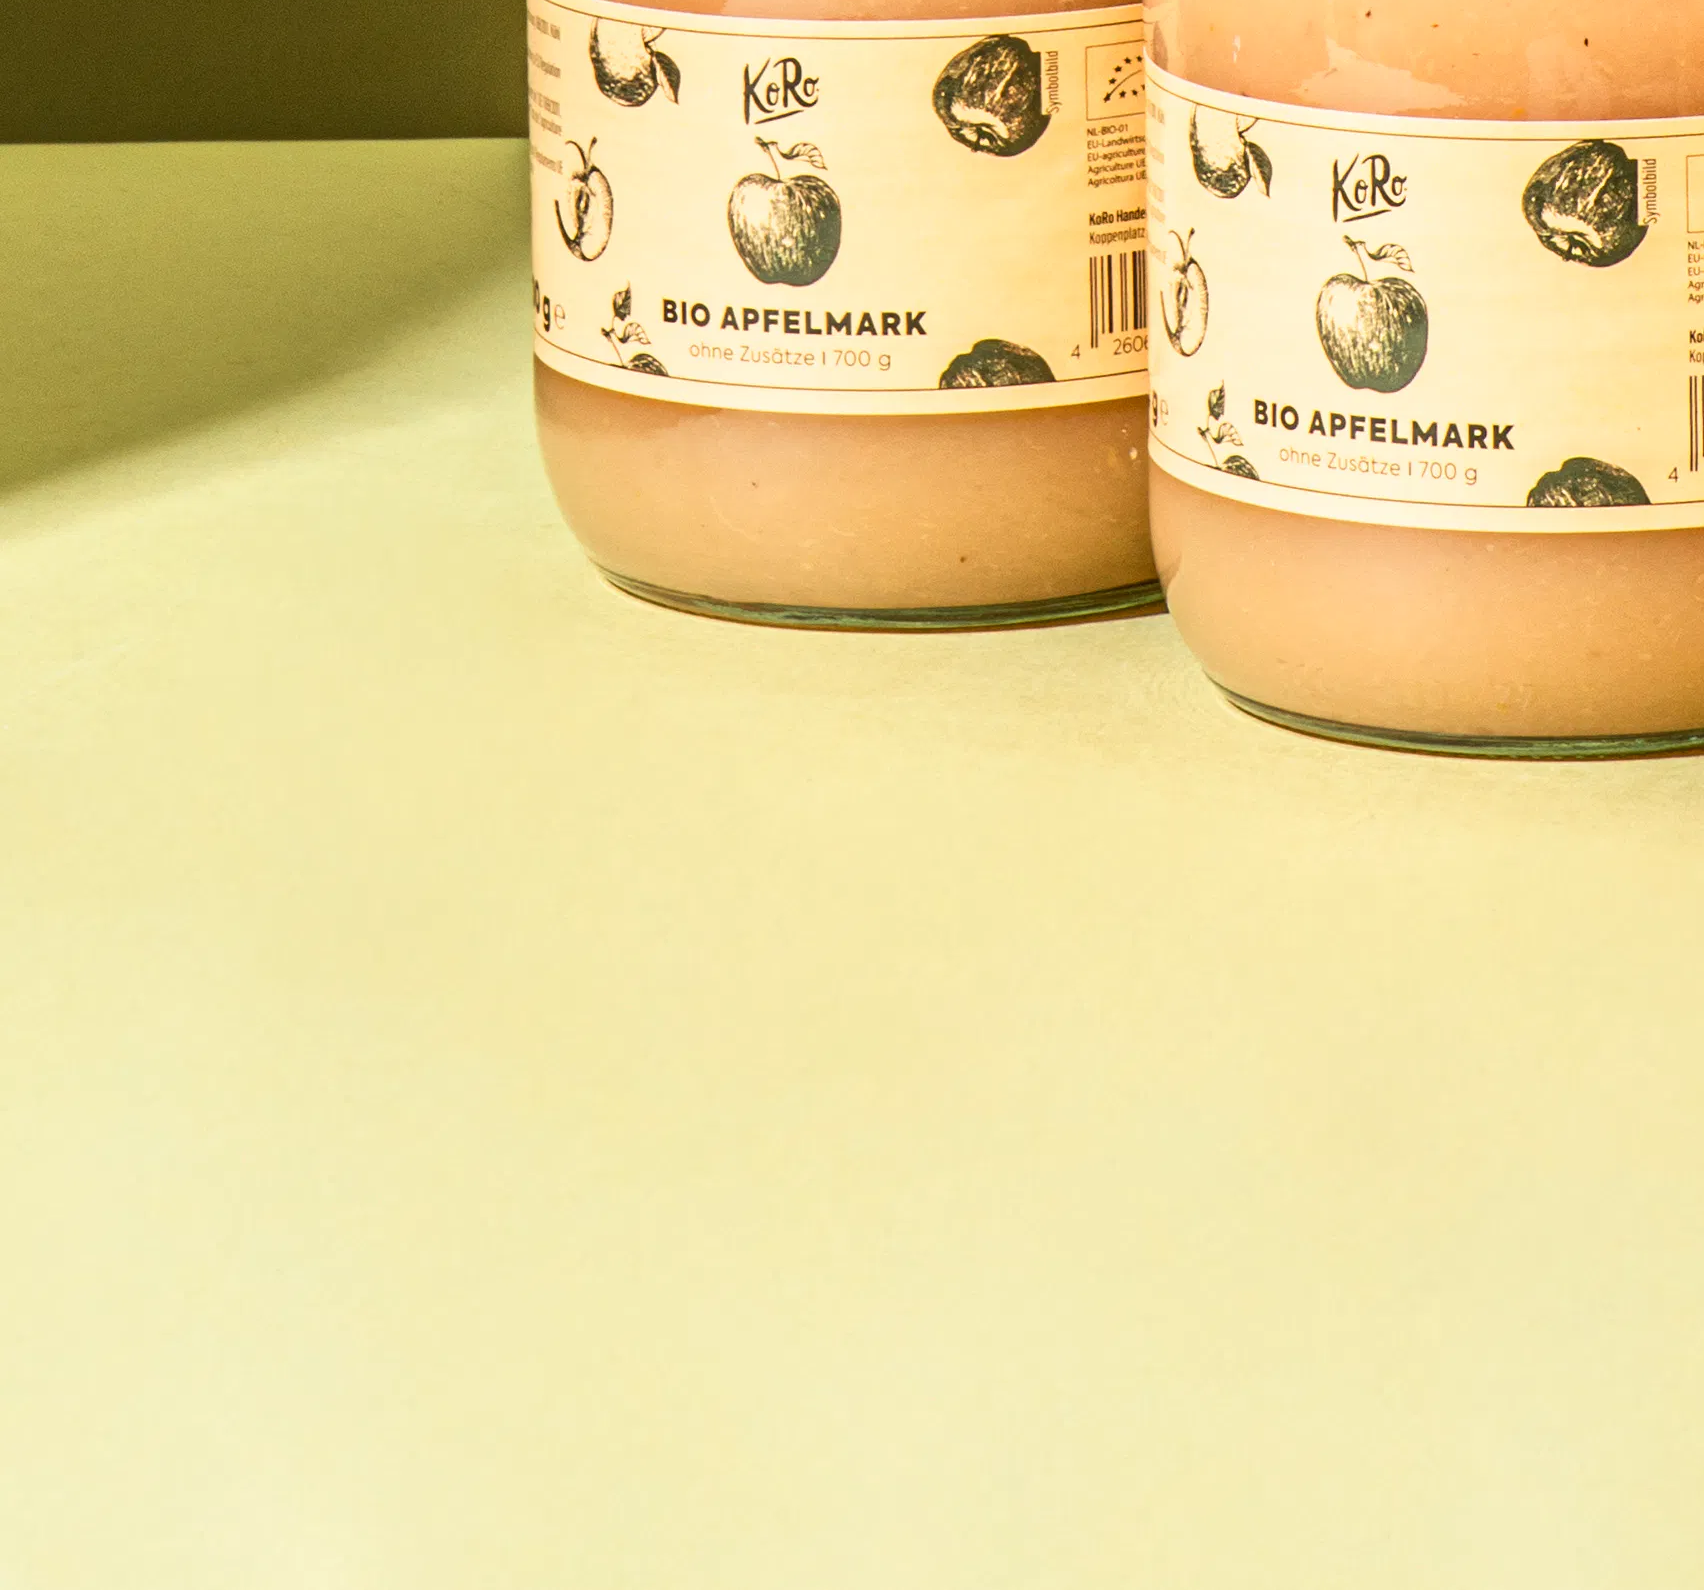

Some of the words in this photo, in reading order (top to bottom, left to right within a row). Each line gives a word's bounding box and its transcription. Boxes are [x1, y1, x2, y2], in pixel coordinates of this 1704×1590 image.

[743, 57, 820, 125] KoRo
[1046, 50, 1063, 115] Symbolbild
[1086, 124, 1129, 136] NL-BIO-01
[1087, 135, 1146, 149] EU-Landwirtsc
[1087, 147, 1146, 162] EU-agriculture
[1088, 160, 1134, 175] Agriculture
[1135, 158, 1146, 168] UE
[1088, 172, 1134, 188] Agricoltura
[1135, 170, 1147, 180] UE
[1332, 153, 1408, 222] KoRo
[1643, 158, 1661, 224] Symbolbild
[1089, 211, 1114, 226] KoRo
[1116, 207, 1146, 222] Hande
[1089, 227, 1145, 245] Koppenplatz
[662, 298, 711, 328] BIO
[720, 305, 928, 336] APFELMARK
[689, 342, 733, 361] ohne
[739, 344, 814, 367] Zusätze
[834, 348, 871, 367] 700
[878, 352, 892, 371] g
[1071, 344, 1081, 360] 4
[1254, 399, 1299, 430] BIO
[1308, 410, 1514, 451] APFELMARK
[1279, 446, 1321, 467] ohne
[1327, 451, 1400, 477] Zusätze
[1420, 461, 1457, 481] 700
[1464, 467, 1478, 485] g
[1668, 466, 1679, 483] 4
